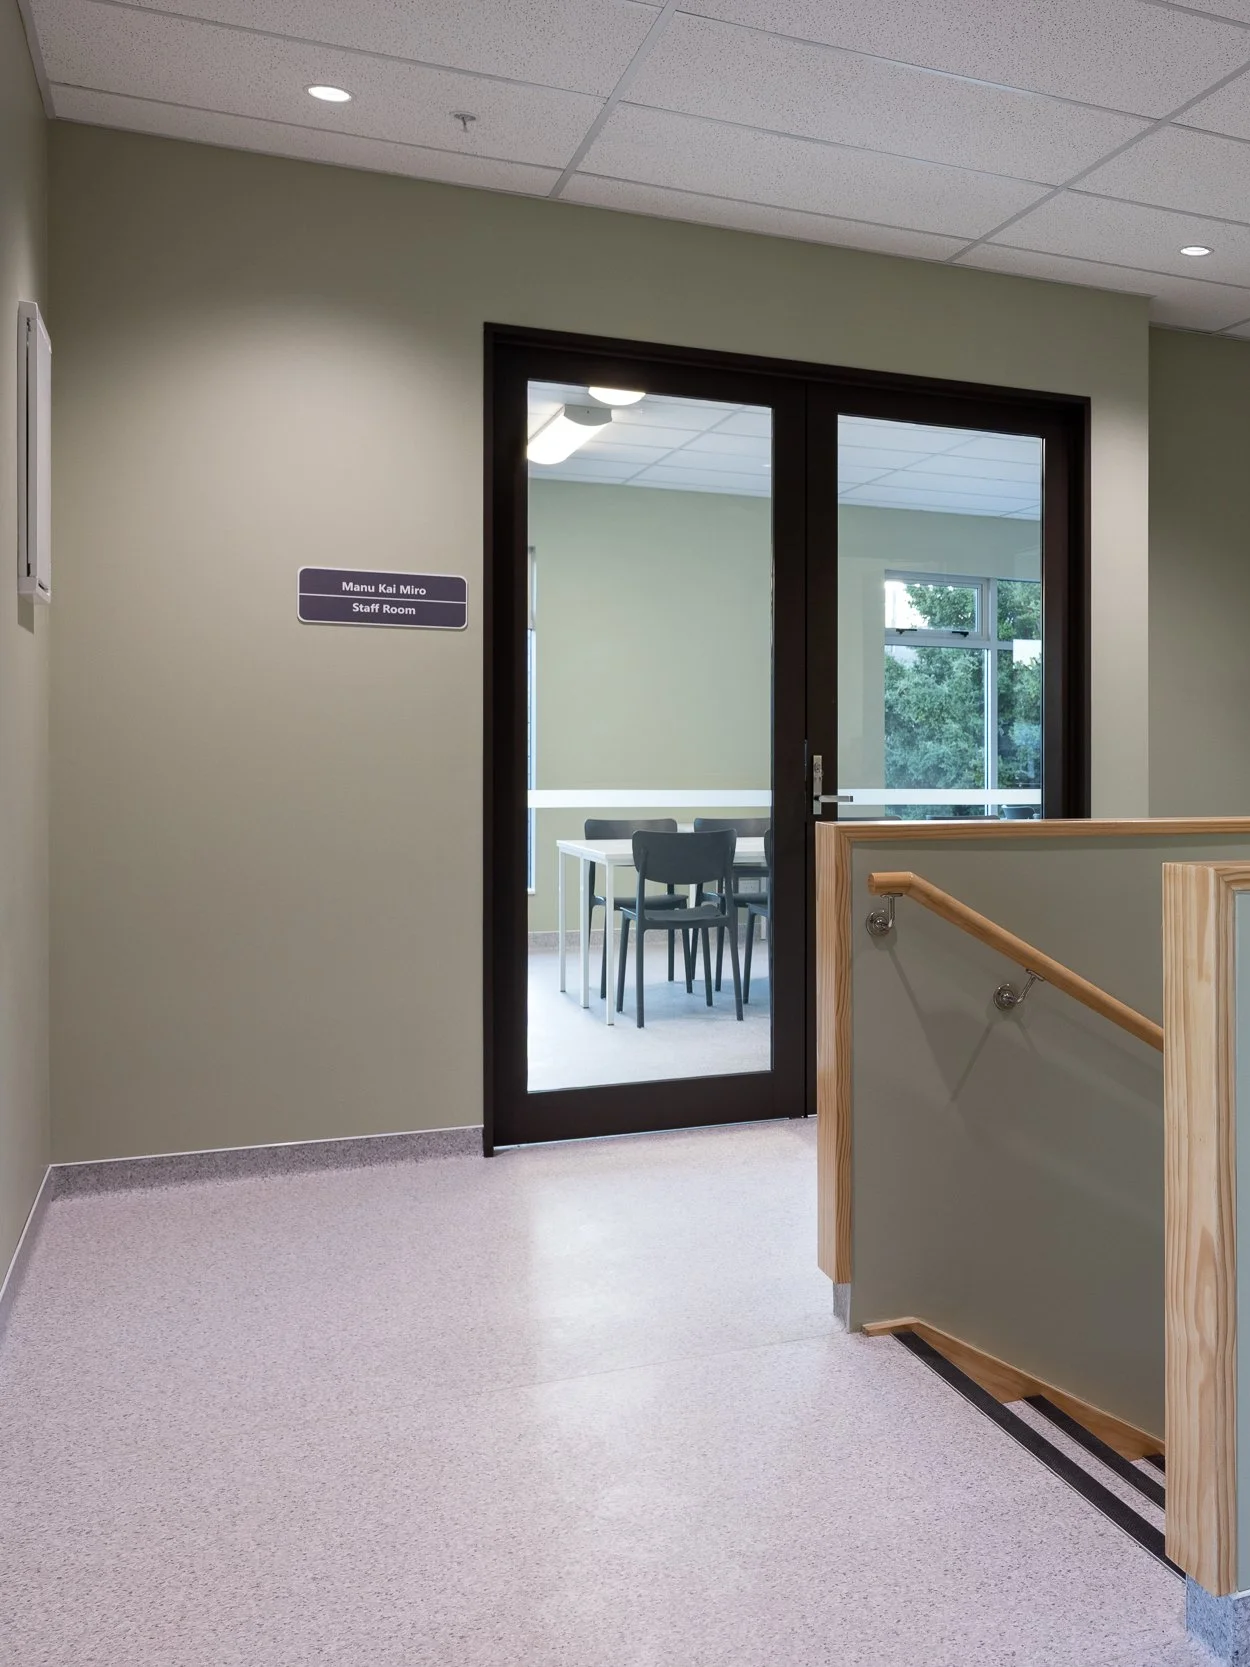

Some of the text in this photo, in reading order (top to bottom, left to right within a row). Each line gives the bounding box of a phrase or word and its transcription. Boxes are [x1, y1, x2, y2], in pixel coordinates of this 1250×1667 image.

[341, 581, 427, 596] Manu Kai Miro
[352, 602, 416, 615] Staff Room
